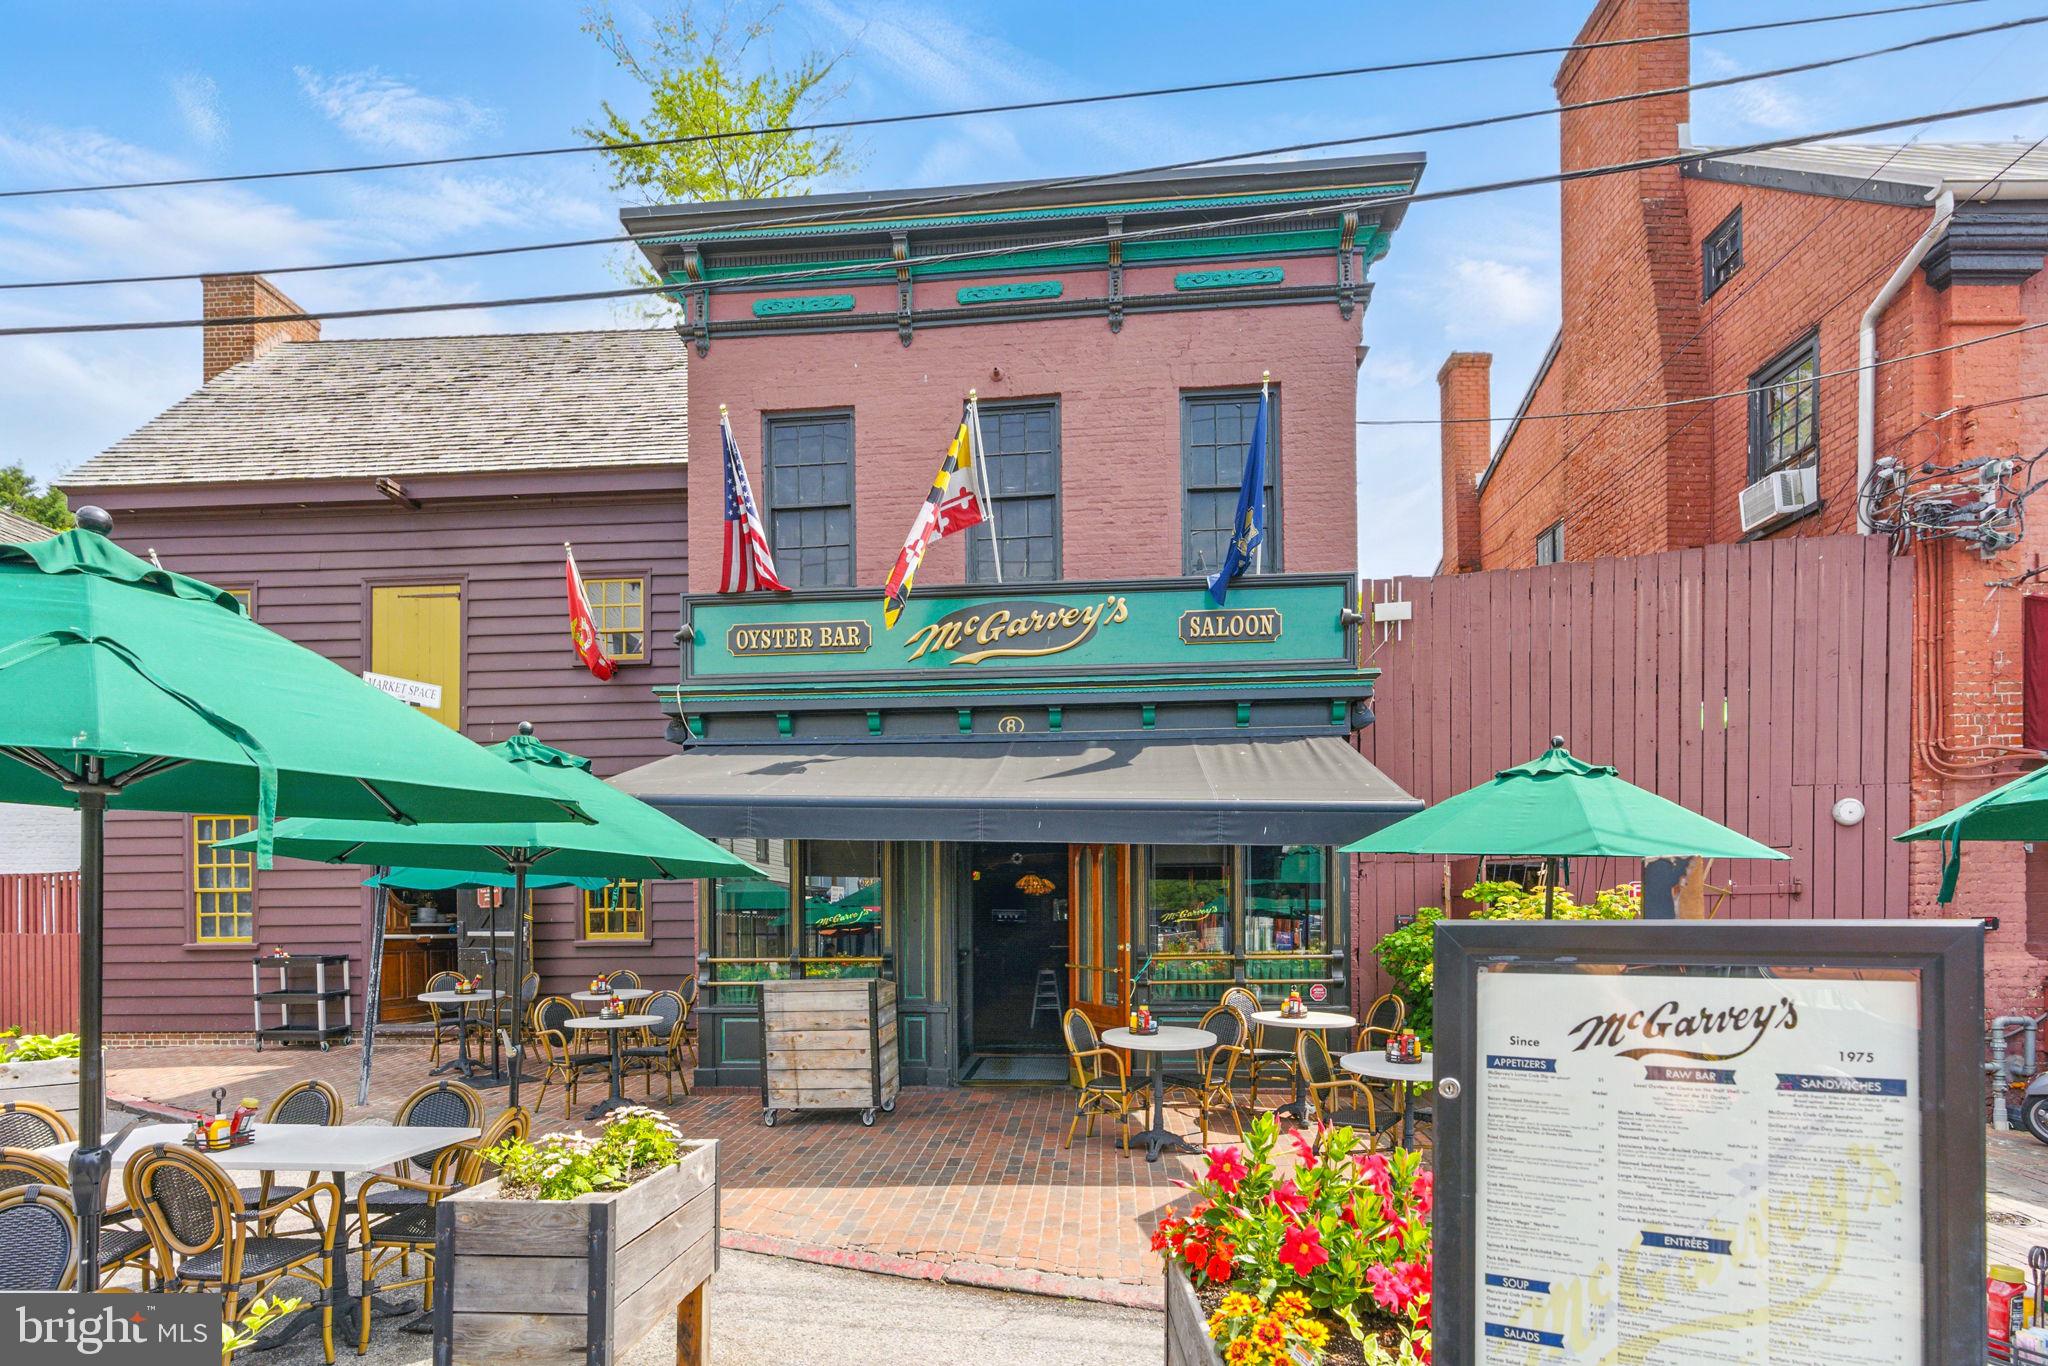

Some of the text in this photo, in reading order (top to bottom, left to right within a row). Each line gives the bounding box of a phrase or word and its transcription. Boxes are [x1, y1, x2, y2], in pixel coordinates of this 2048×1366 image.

[905, 596, 1128, 665] McGarvey's
[1189, 614, 1275, 638] SALOON
[736, 624, 862, 651] OYSTER BAR
[408, 684, 437, 700] SPACE
[1006, 719, 1016, 733] 8
[1568, 997, 1798, 1062] McGarvey's
[1509, 1035, 1540, 1047] Since
[1493, 1058, 1547, 1070] APPETIZERS
[1838, 1050, 1875, 1064] 1975
[1665, 1069, 1716, 1081] RAW BAR
[1800, 1078, 1882, 1092] SANDWICHES
[1664, 1236, 1709, 1250] ENTRÉES
[1502, 1277, 1530, 1289] SOUP
[1503, 1327, 1540, 1342] SALADS
